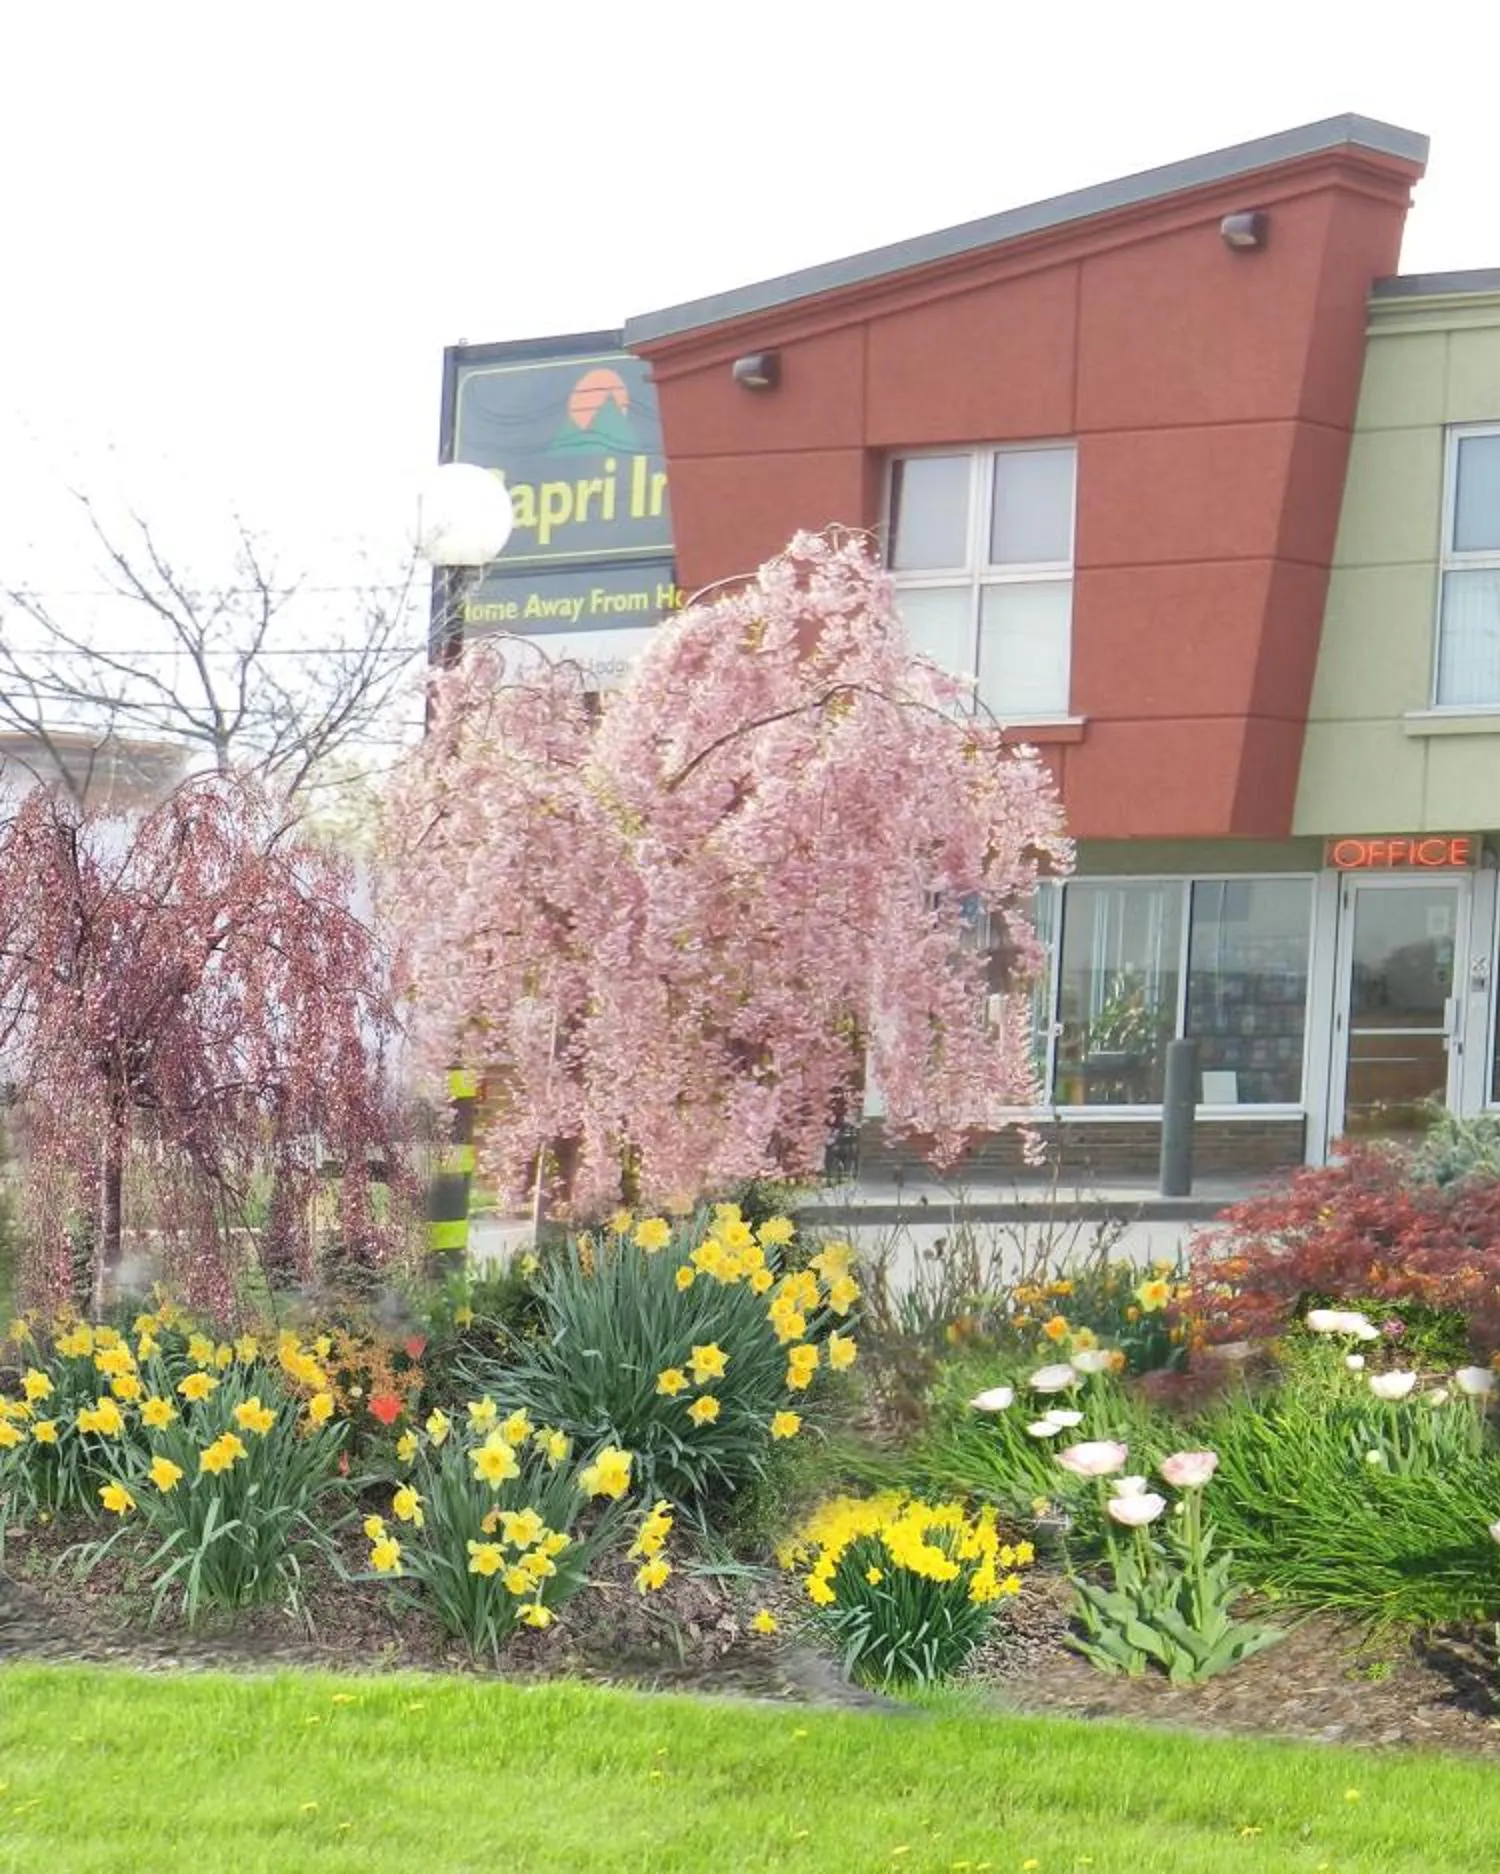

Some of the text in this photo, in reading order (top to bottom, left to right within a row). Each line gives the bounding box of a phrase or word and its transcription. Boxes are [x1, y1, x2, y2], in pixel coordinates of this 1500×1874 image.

[488, 457, 617, 545] apri
[524, 593, 584, 623] Away
[590, 587, 649, 614] From
[1334, 839, 1469, 867] OFFICE
